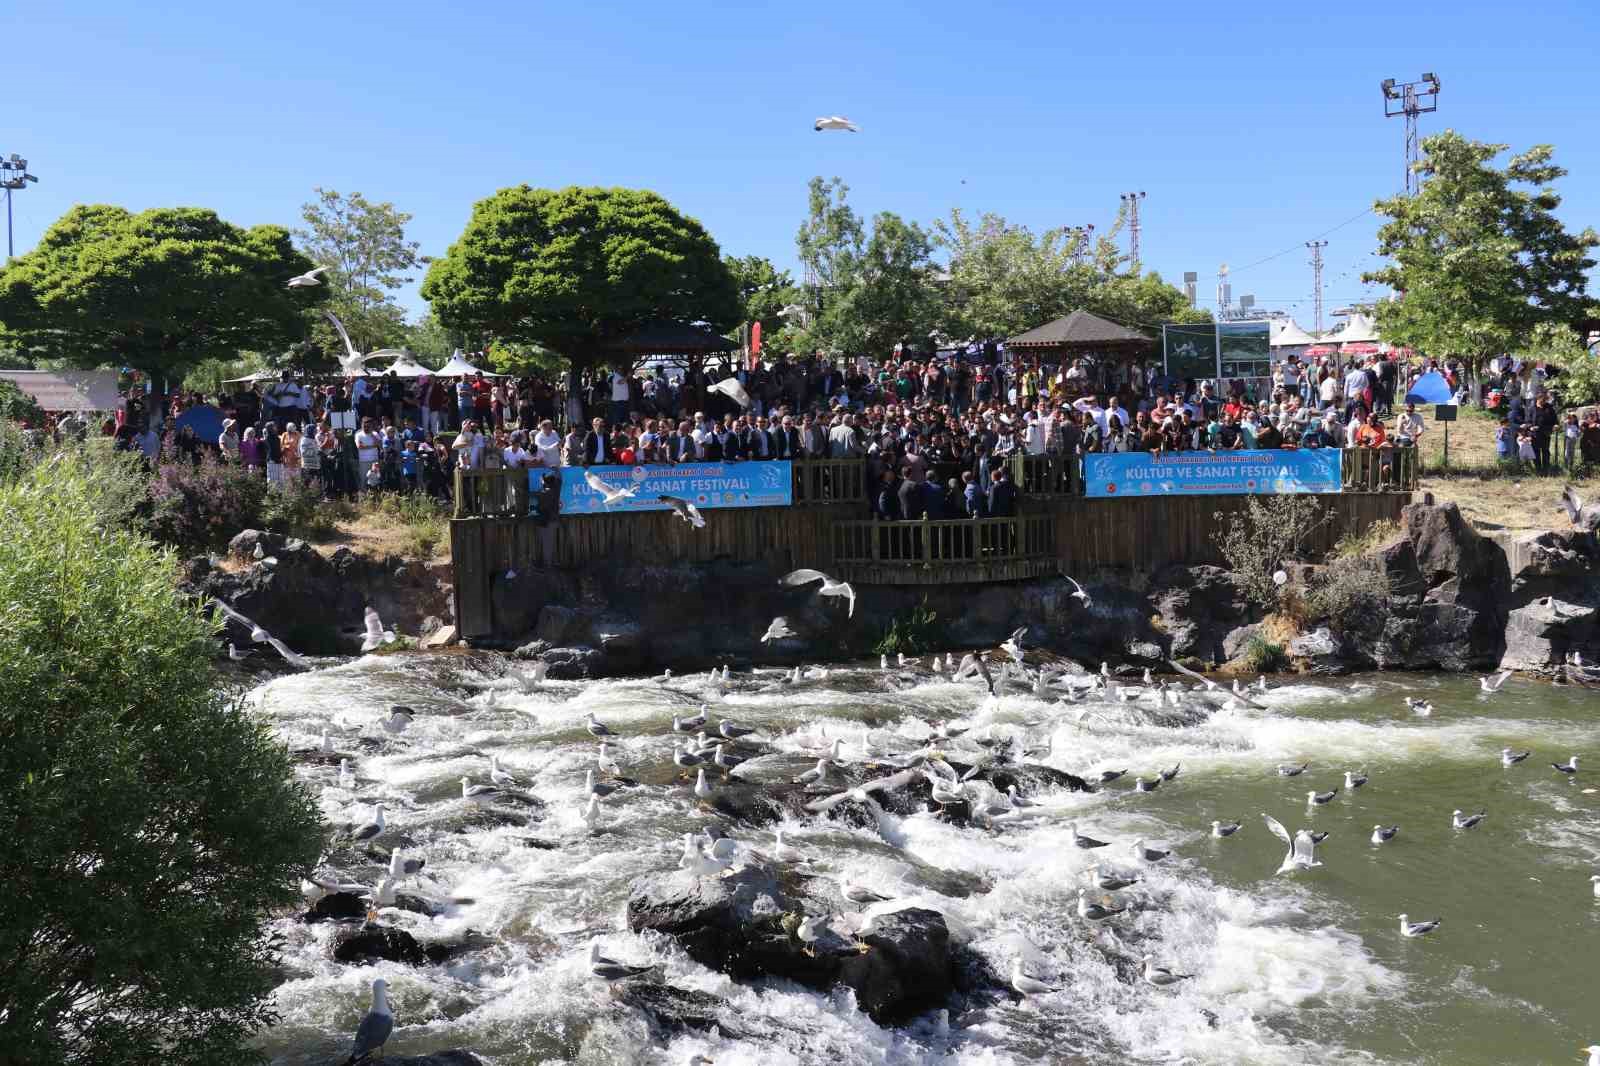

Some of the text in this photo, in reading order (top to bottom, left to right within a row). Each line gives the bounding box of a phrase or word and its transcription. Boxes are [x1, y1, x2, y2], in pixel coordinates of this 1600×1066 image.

[1126, 465, 1173, 480] KÜLTÜR
[1177, 467, 1193, 479] VE
[1196, 466, 1237, 478] SANAT
[645, 480, 687, 493] SANAT
